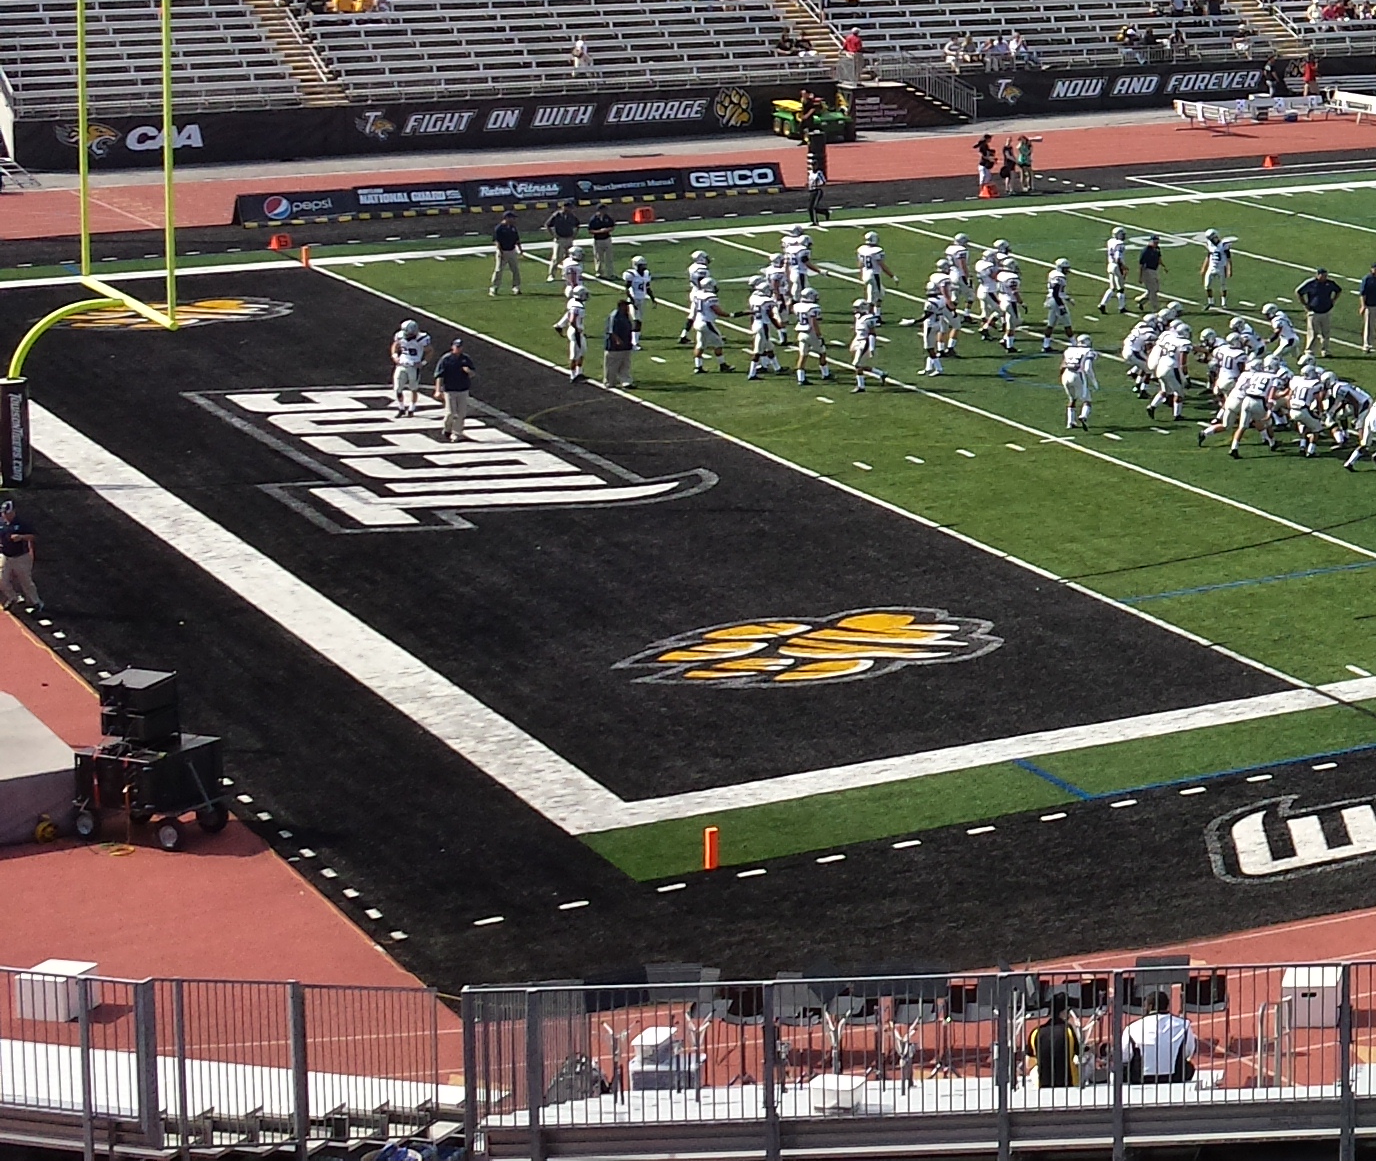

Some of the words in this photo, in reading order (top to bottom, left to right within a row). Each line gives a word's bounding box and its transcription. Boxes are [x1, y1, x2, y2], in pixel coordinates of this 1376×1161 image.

[1051, 78, 1107, 98] NOW
[1113, 76, 1159, 96] AND
[1166, 70, 1262, 92] FOREVER
[403, 110, 476, 134] FIGHT
[486, 109, 520, 129] ON
[532, 105, 593, 127] WITH
[607, 99, 707, 123] COURAGE
[125, 125, 204, 151] CAA
[689, 168, 775, 187] GEICO
[291, 197, 333, 214] pepsi
[358, 191, 410, 205] NATIONAL
